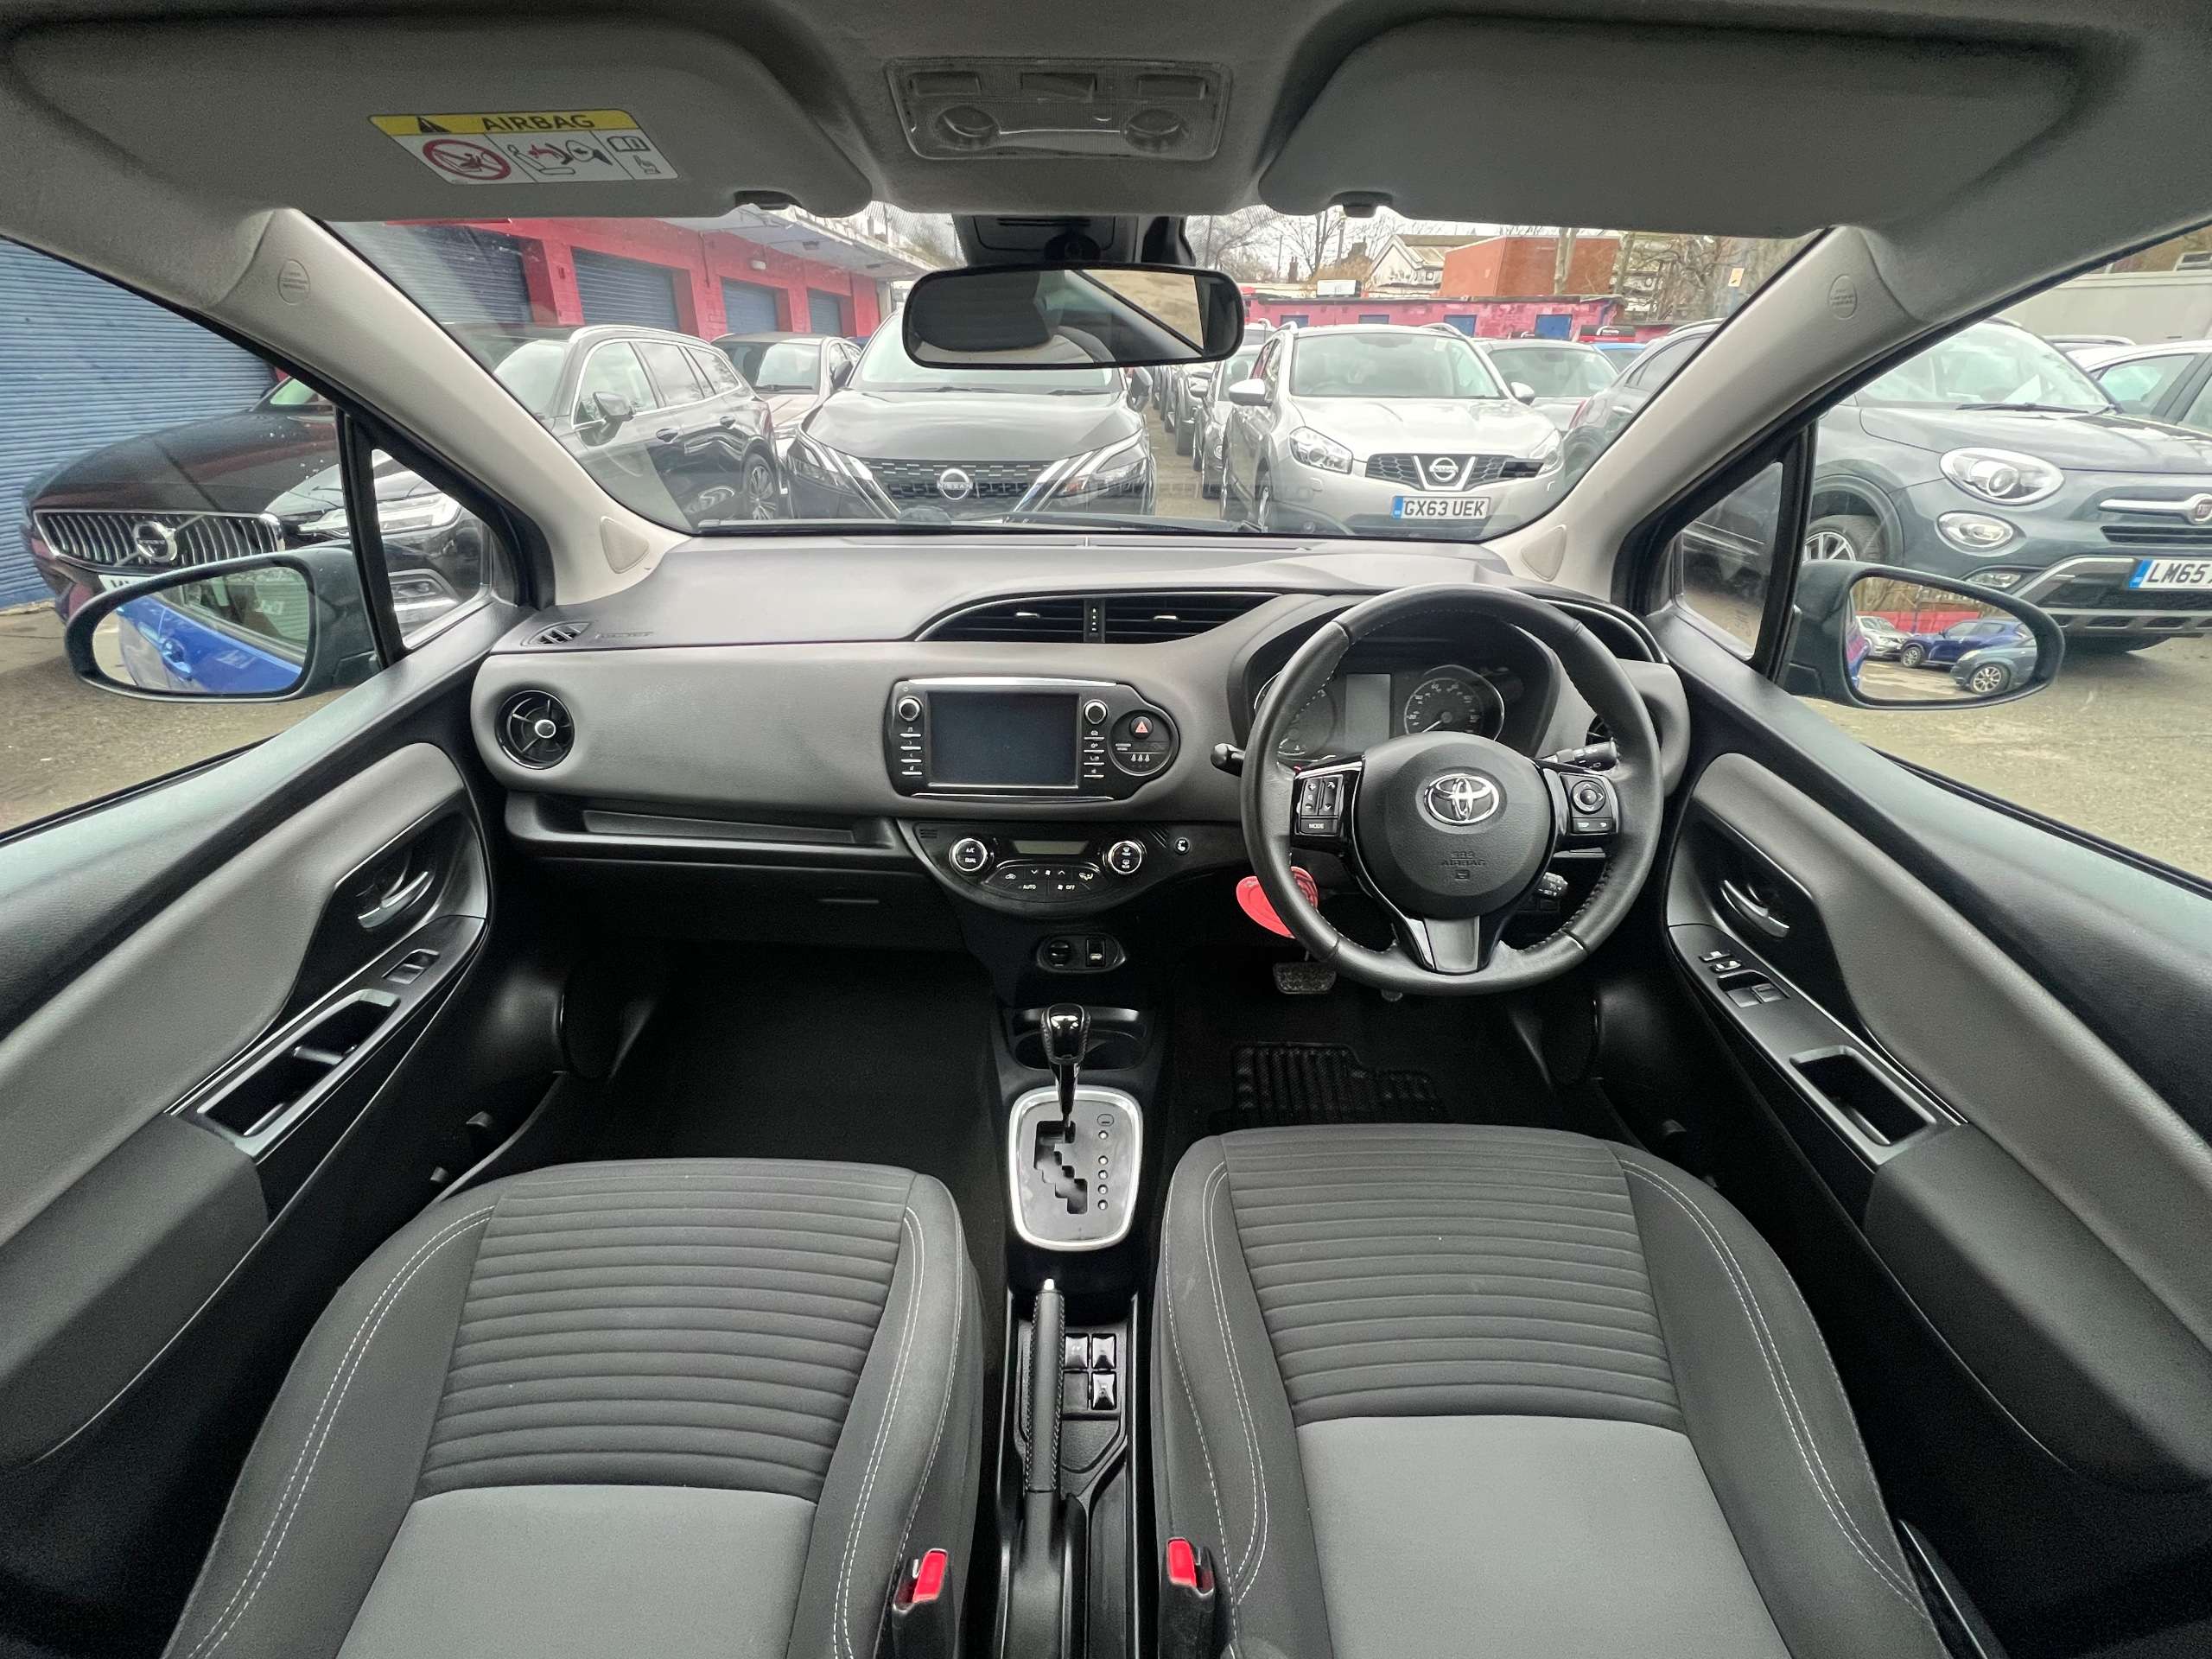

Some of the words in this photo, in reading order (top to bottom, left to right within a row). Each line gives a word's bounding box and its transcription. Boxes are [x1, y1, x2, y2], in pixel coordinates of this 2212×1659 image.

[483, 114, 595, 131] AIRBAG
[1404, 500, 1448, 517] GX63
[1452, 500, 1485, 517] UEK
[2146, 563, 2211, 583] LM65
